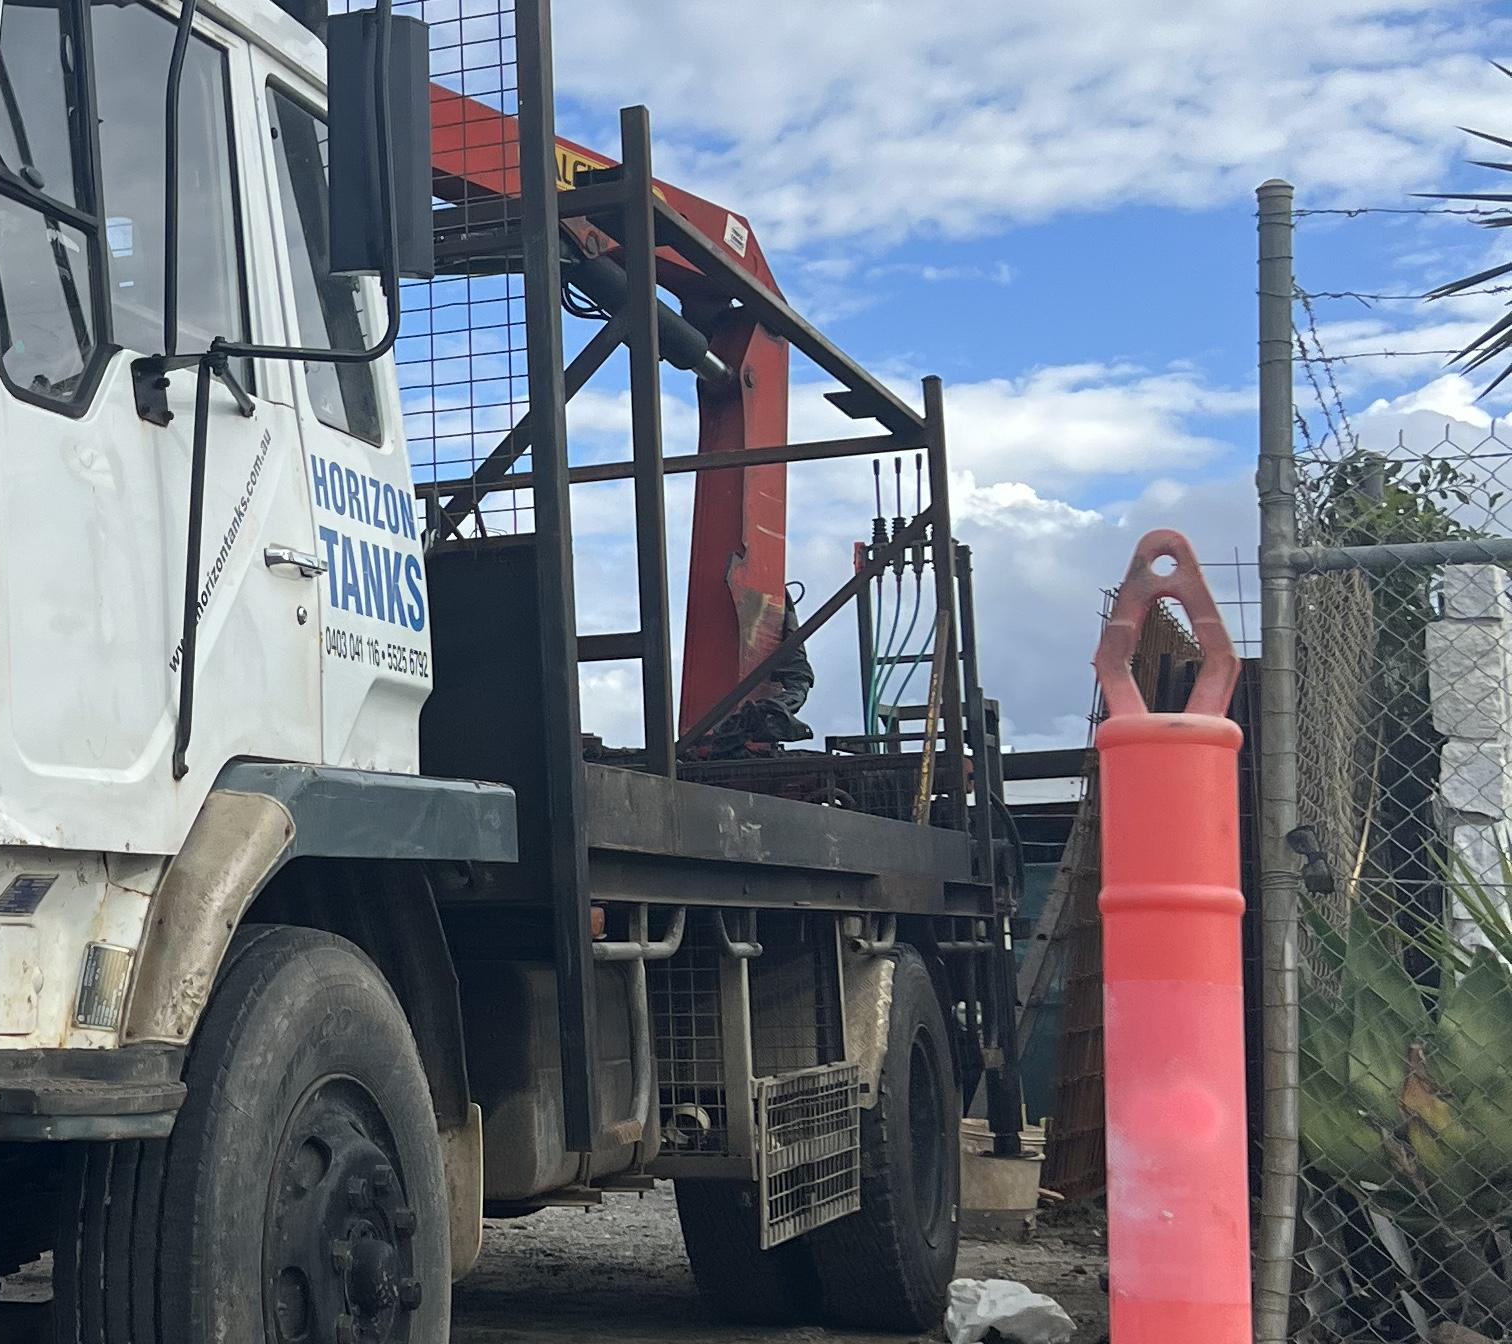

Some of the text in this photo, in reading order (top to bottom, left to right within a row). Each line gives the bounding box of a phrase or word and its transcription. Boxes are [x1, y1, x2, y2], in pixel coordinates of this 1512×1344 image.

[311, 454, 417, 540] HORIZON
[319, 525, 426, 632] TANKS
[326, 626, 348, 659] 0403
[350, 632, 364, 663] 041
[367, 636, 380, 667] 116
[388, 643, 407, 674] 5525
